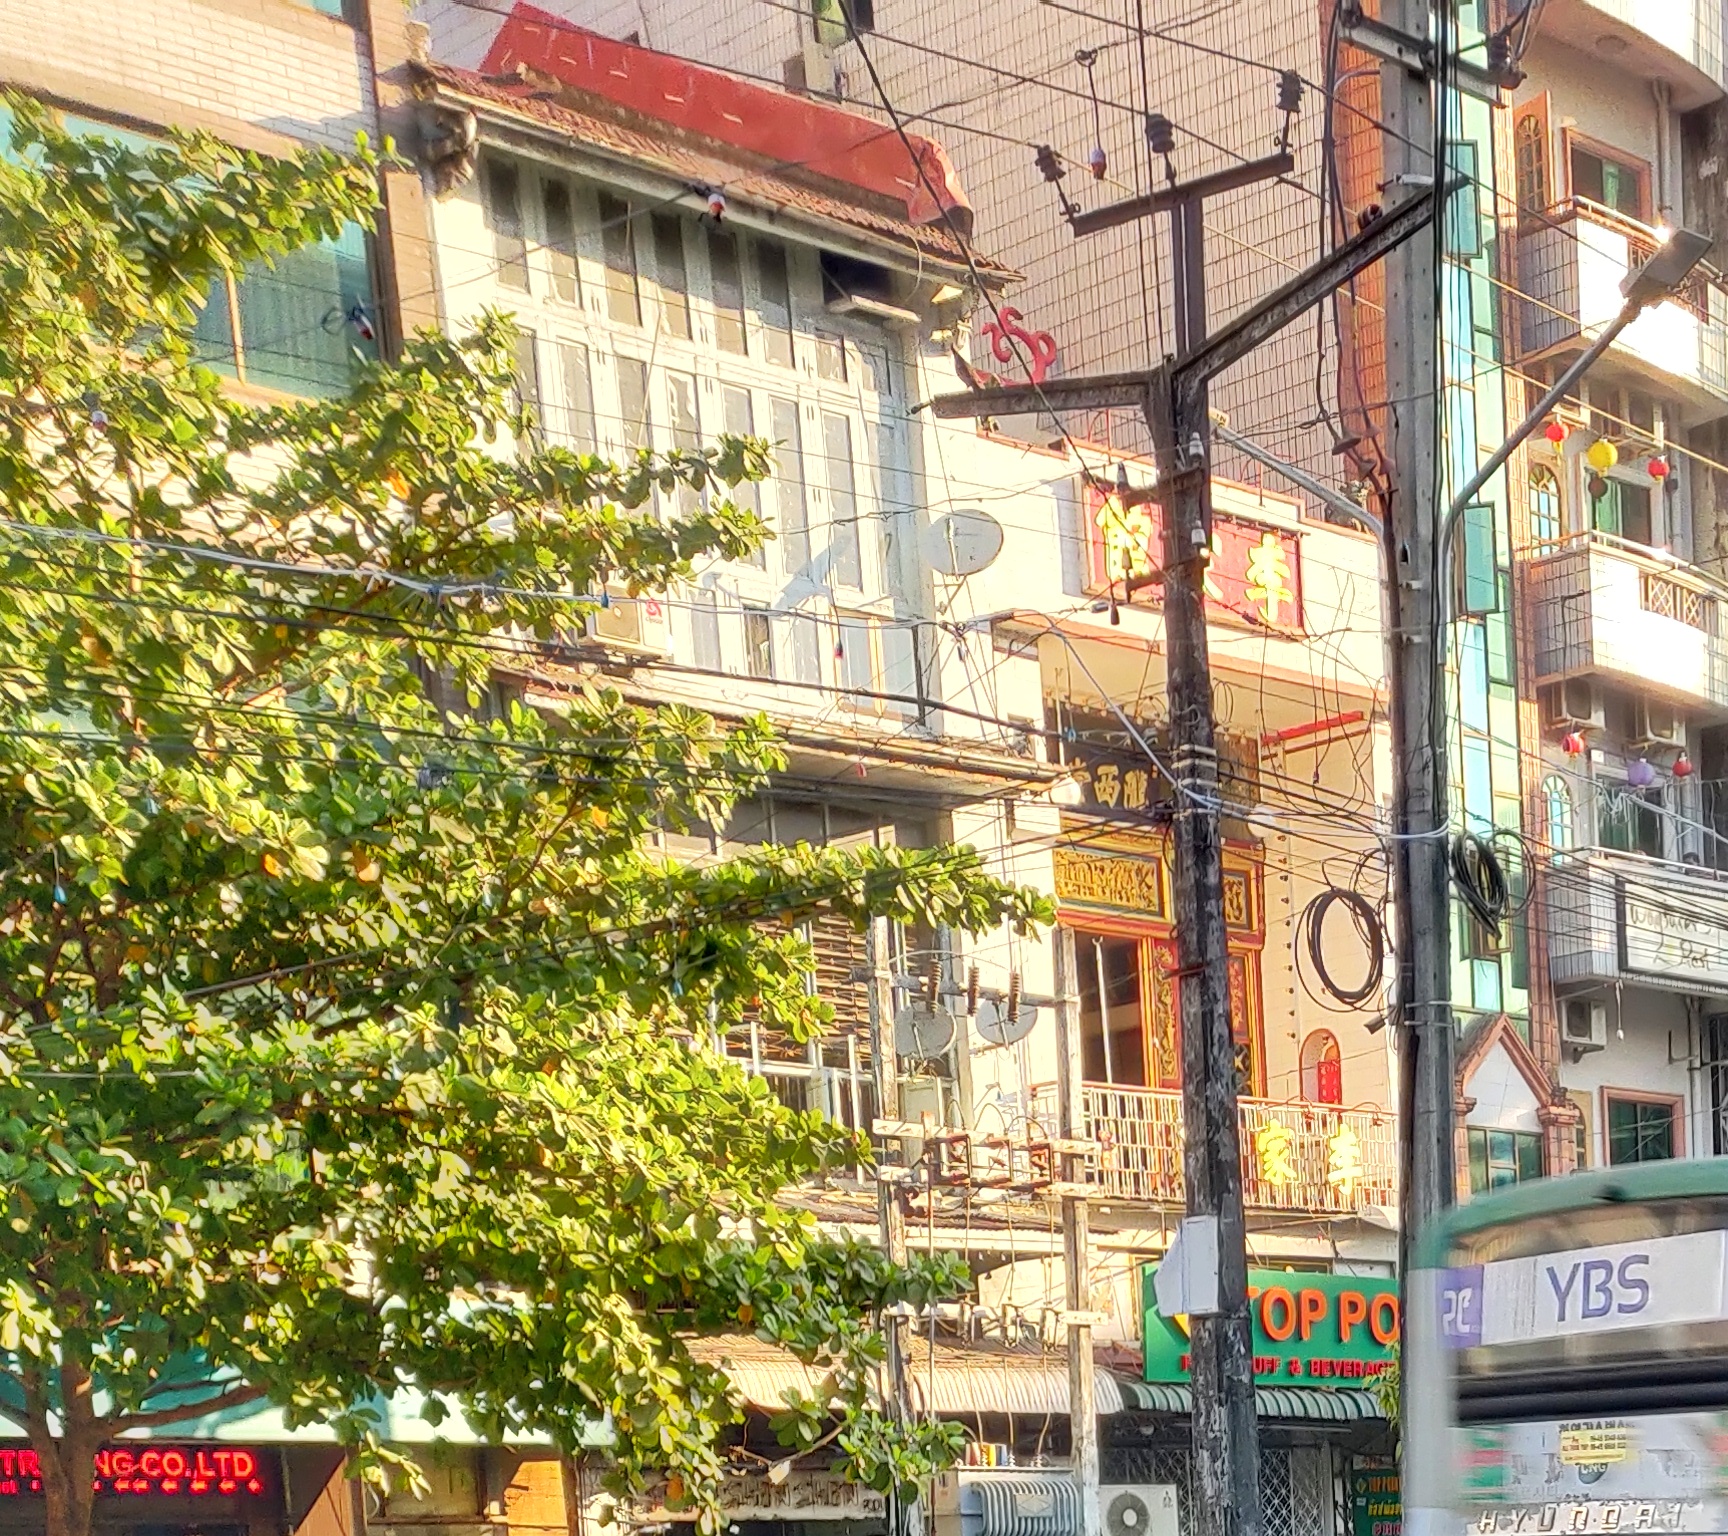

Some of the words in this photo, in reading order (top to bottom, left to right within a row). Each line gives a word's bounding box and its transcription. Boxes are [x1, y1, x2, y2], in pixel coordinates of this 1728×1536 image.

[1339, 1290, 1399, 1345] PO
[1545, 1253, 1651, 1332] YBS
[0, 1450, 133, 1478] TRNG
